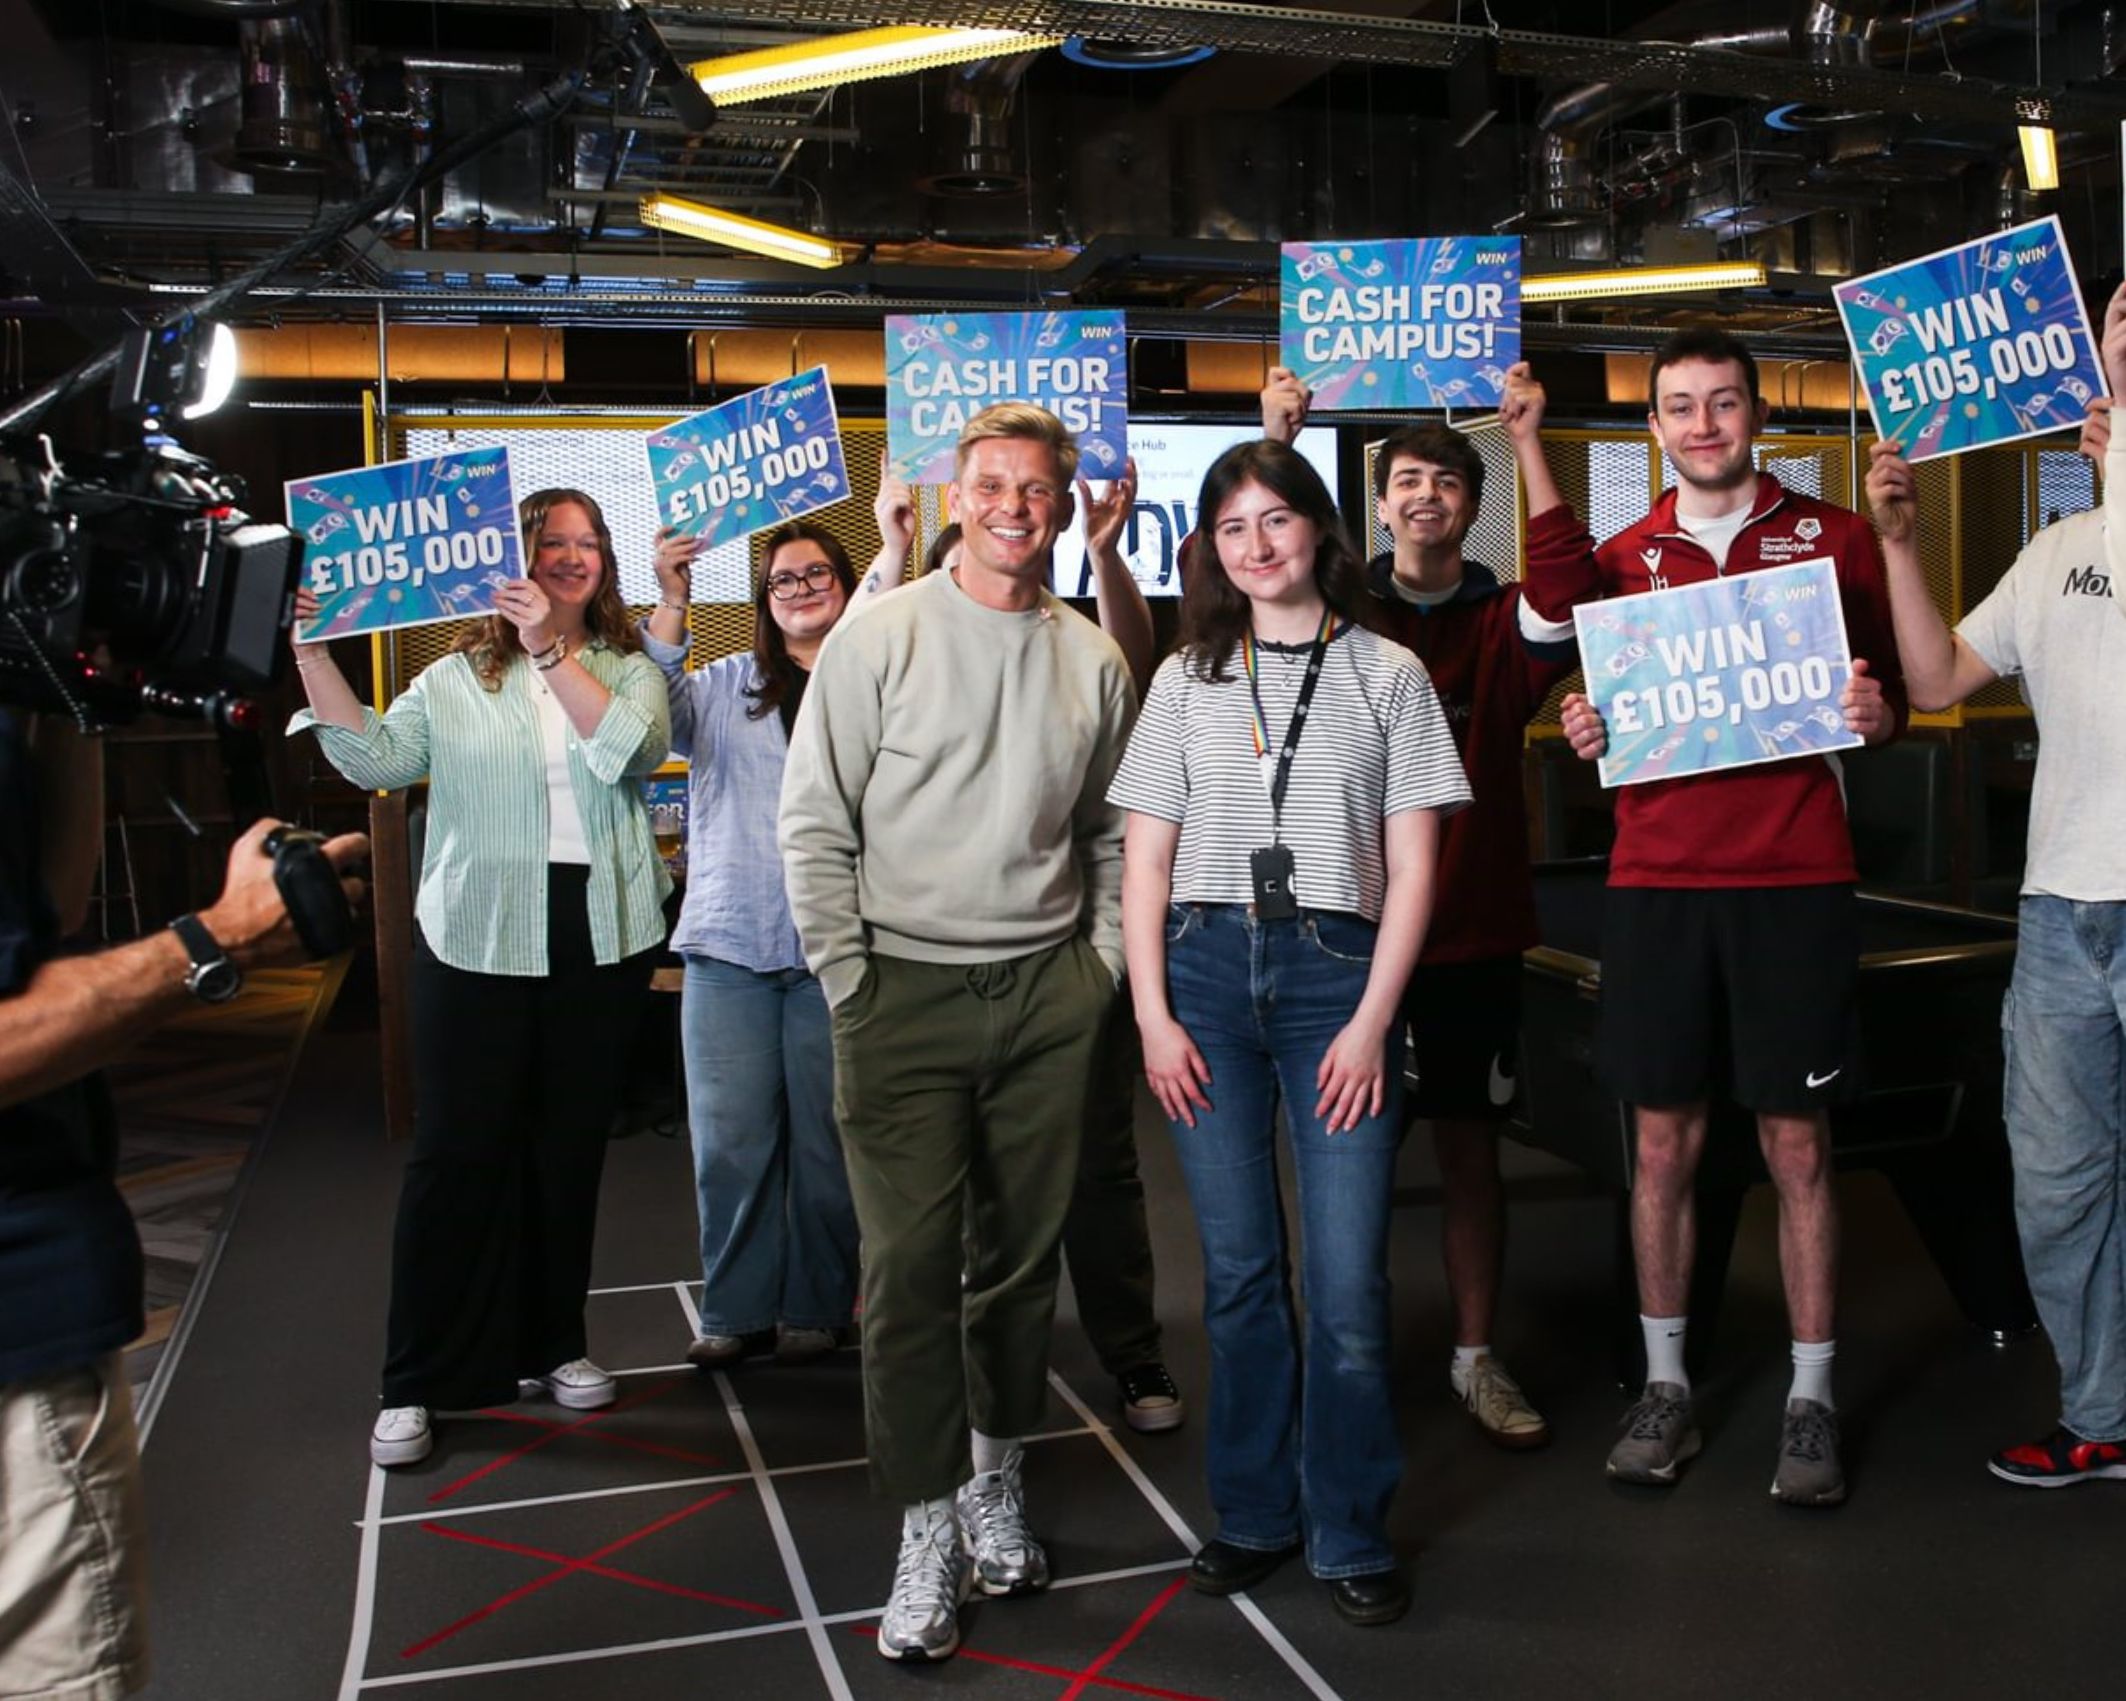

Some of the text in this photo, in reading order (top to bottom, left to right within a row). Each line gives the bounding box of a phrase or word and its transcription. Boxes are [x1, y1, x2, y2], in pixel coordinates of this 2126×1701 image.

[1476, 252, 1507, 265] WIN
[2016, 245, 2047, 265] WIN
[1299, 283, 1504, 323] CASH FOR
[1908, 287, 2011, 353] WIN
[1081, 326, 1112, 338] WIN
[1304, 322, 1494, 362] CAMPUS!
[904, 357, 1111, 398] CASH FOR
[1881, 323, 2076, 413] £105,000
[792, 383, 817, 400] WIN
[701, 417, 781, 474] WIN
[1142, 439, 1167, 450] Hub
[467, 464, 496, 478] WIN
[671, 435, 829, 524] £105,000
[353, 494, 449, 544] WIN
[311, 526, 504, 595] £105,000
[1785, 585, 1816, 600] WIN
[1656, 620, 1767, 678] WIN
[1612, 655, 1831, 735] £105,000
